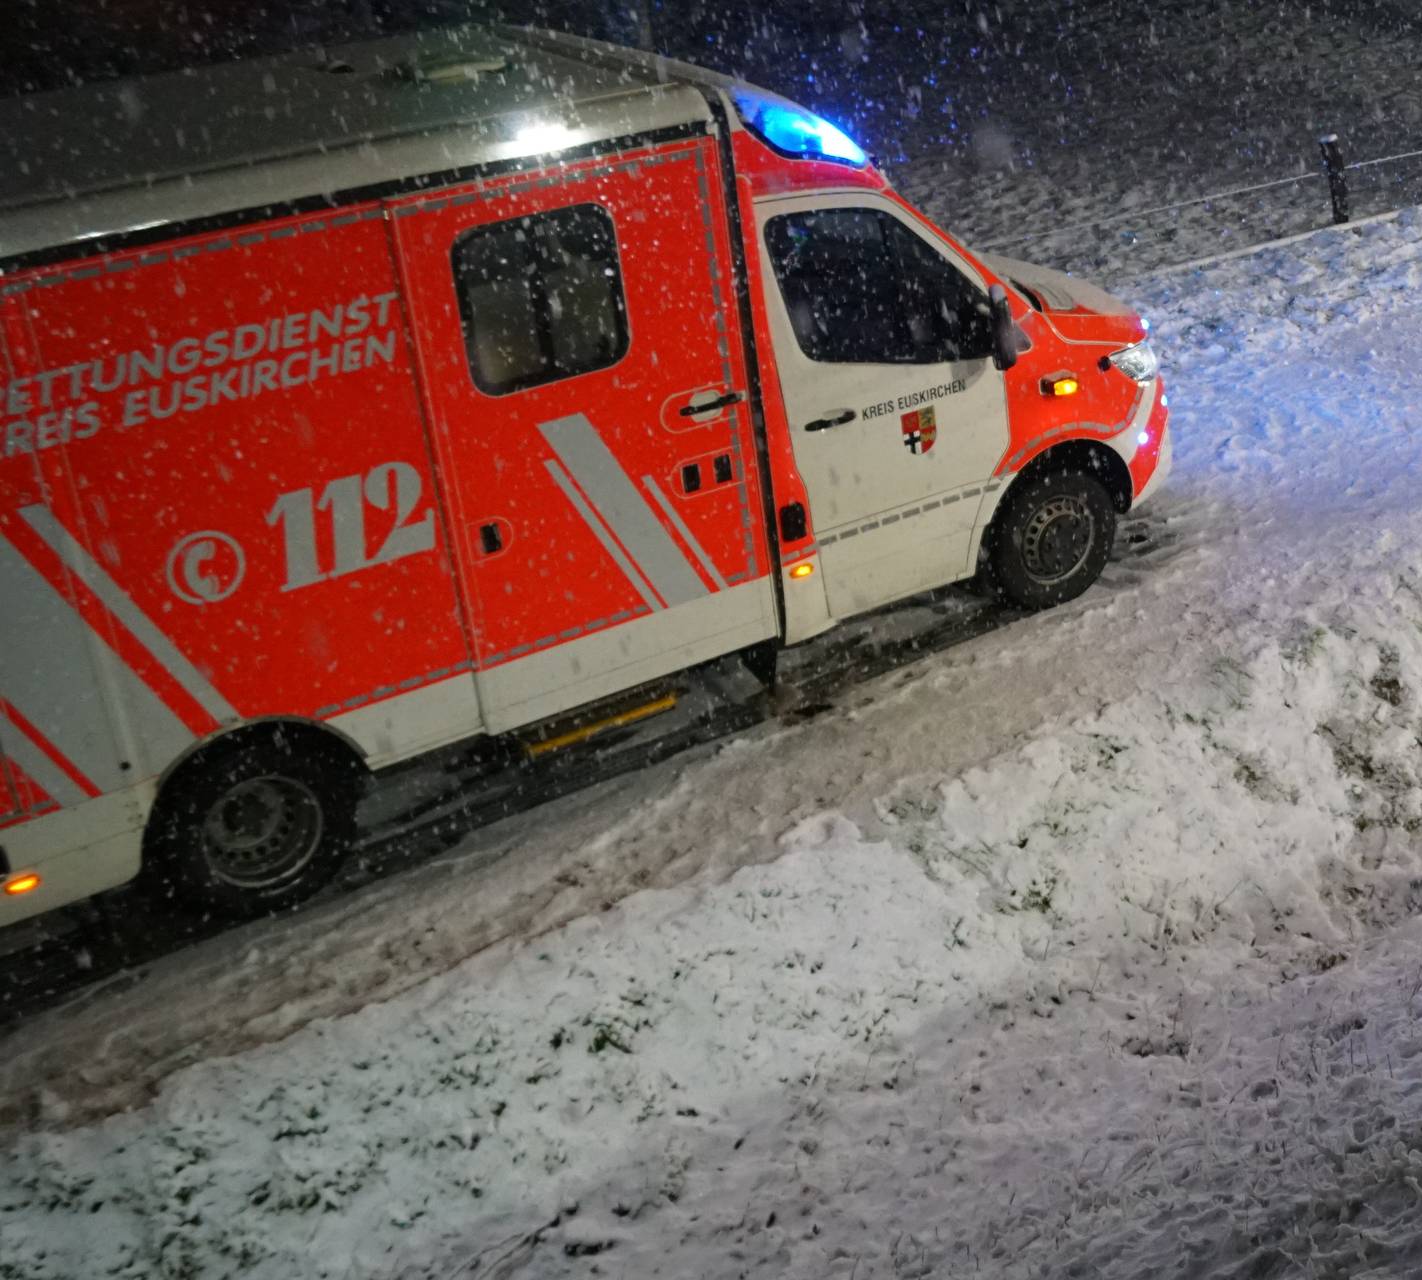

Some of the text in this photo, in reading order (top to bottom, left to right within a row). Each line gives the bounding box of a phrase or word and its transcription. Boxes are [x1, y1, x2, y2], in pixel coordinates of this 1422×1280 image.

[0, 292, 398, 418] ETTUNGSDIENST
[0, 330, 396, 458] REIS EUSKIRCHEN
[862, 379, 966, 421] KREIS EUSKIRCHEN
[265, 461, 435, 592] 112
